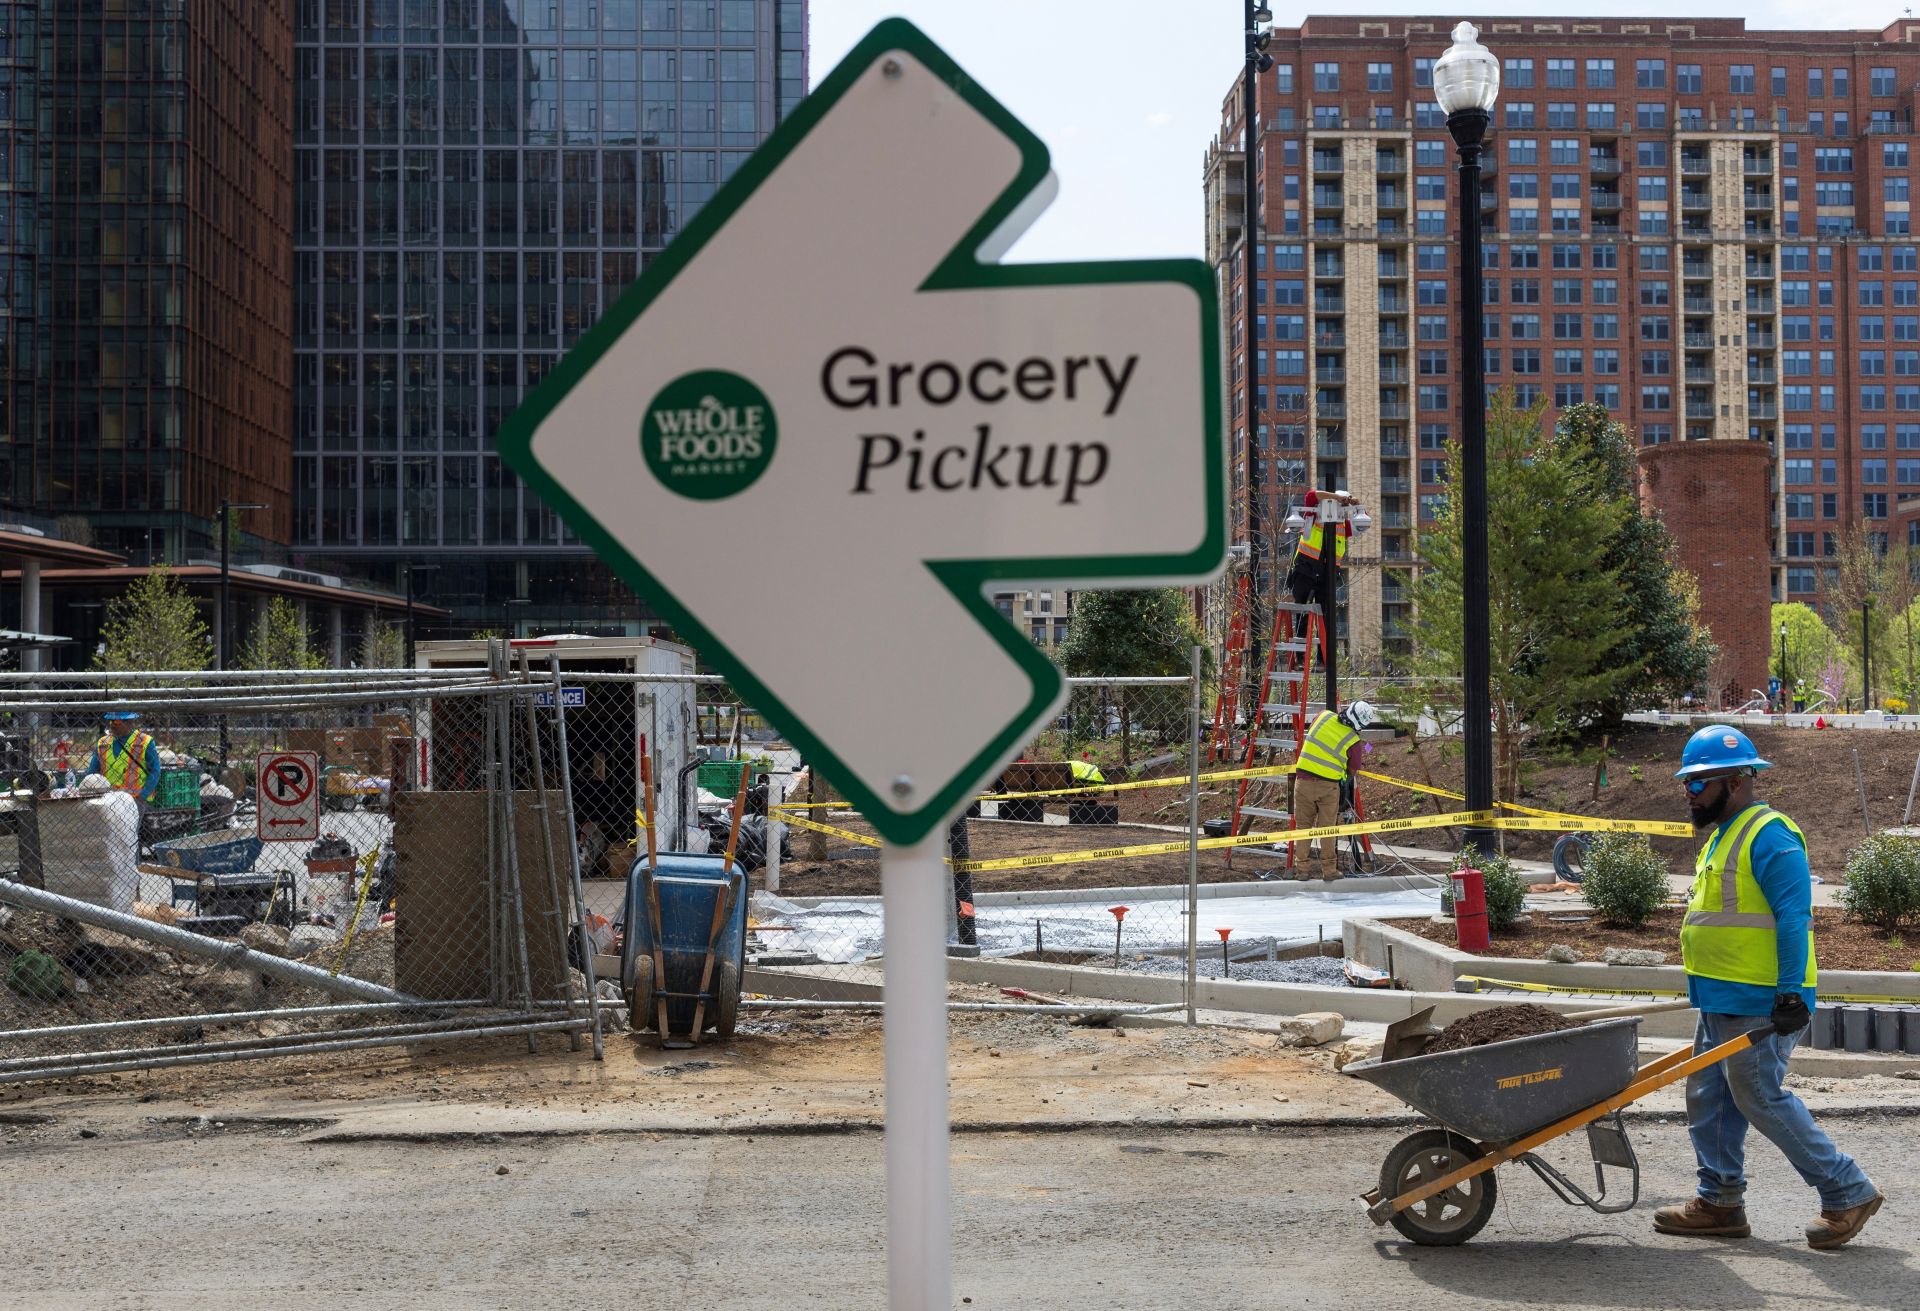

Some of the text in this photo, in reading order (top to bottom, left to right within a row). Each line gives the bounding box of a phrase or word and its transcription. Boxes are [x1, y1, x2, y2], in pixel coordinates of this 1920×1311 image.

[820, 345, 1140, 416] Grocery
[654, 404, 764, 434] WHOLE
[661, 431, 762, 461] FOODS
[671, 461, 746, 476] MARKET
[850, 423, 1111, 505] Pickup
[547, 691, 582, 704] FNCE
[1504, 819, 1530, 827] CAUTION
[1559, 820, 1584, 829] CAUTION
[1022, 855, 1053, 866] CAUTION
[1093, 849, 1125, 859] CAUTION
[1236, 835, 1268, 845] CAUTION
[1308, 828, 1340, 837] CAUTION
[1380, 820, 1412, 830] CAUTION
[1453, 813, 1485, 823] CAUTION
[1496, 1075, 1521, 1090] TRUE
